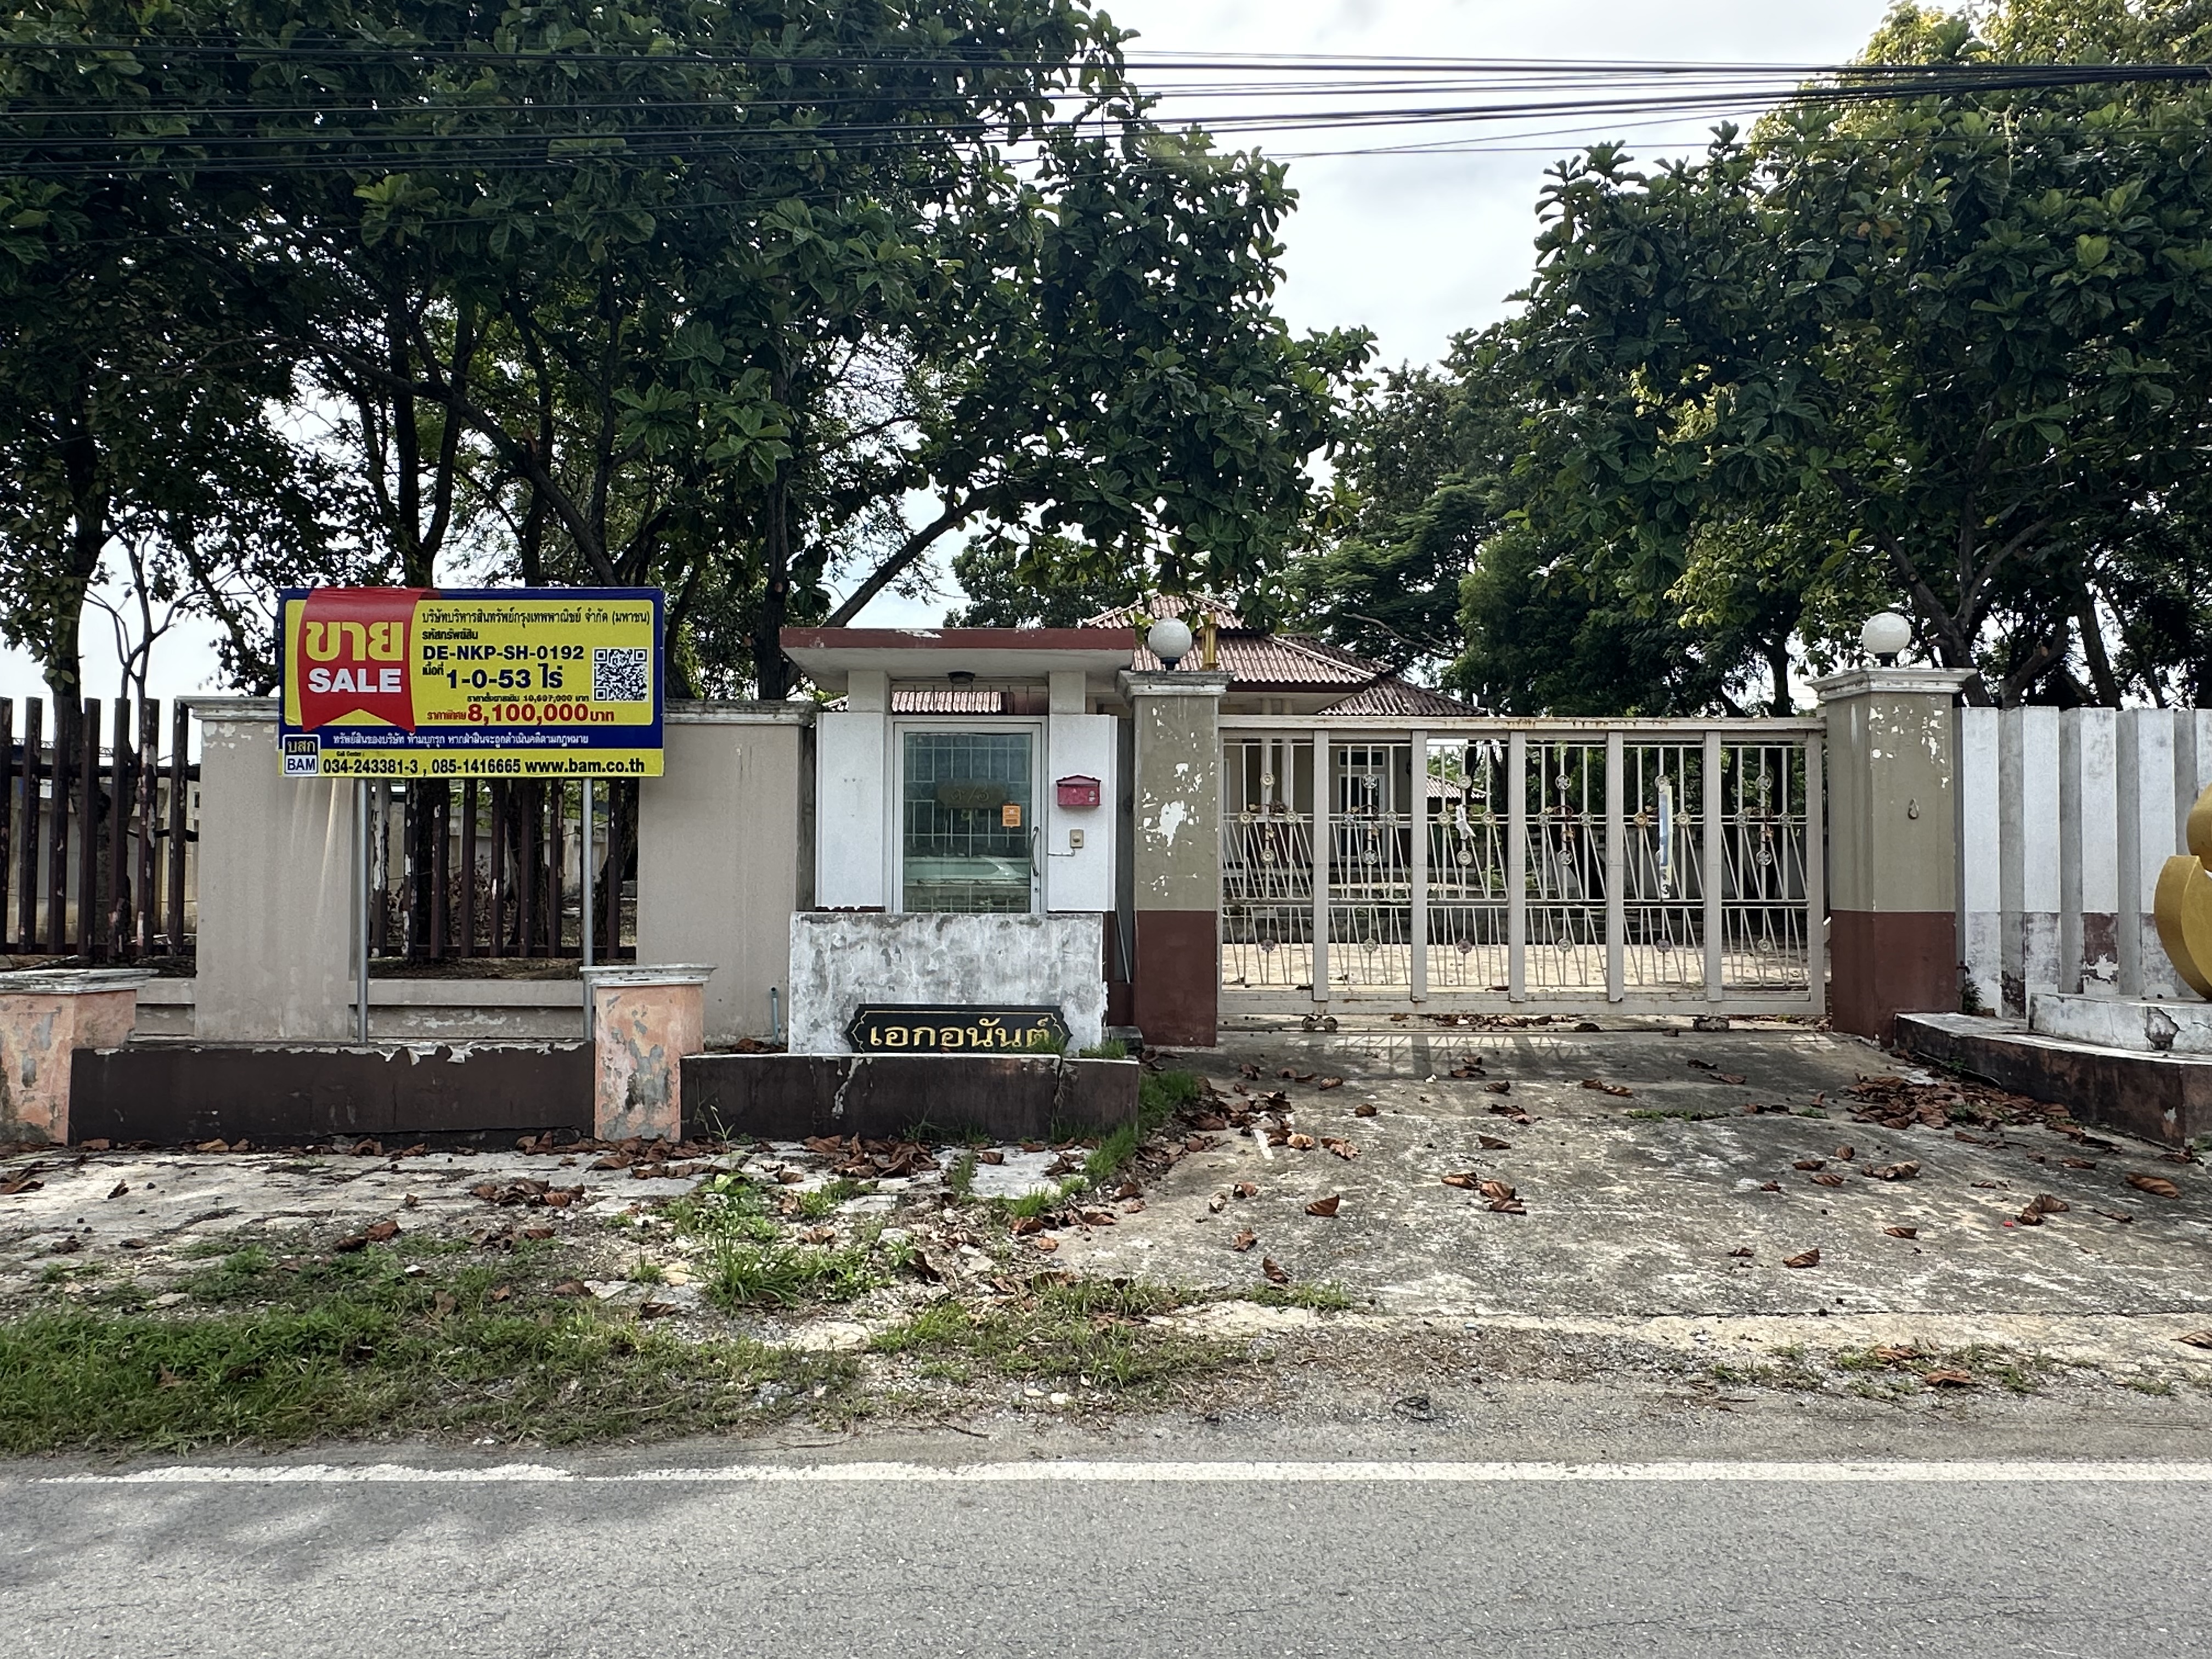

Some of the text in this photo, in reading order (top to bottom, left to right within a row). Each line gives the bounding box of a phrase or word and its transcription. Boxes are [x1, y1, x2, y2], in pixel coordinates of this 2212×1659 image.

[585, 608, 608, 623] จำกัด
[612, 610, 650, 625] (มหาชน)
[306, 621, 404, 662] ขาย
[422, 645, 584, 660] DE-NKP-SH-0192
[308, 667, 402, 693] SALE
[422, 661, 563, 689] เนื้อที่ 1-0-53 ไร่
[467, 703, 589, 726] 8,100,000
[590, 710, 614, 722] บาท
[287, 740, 316, 754] บสก
[287, 758, 316, 771] BAM
[323, 758, 418, 774] 034-243381-3
[432, 759, 521, 774] 085-1416665
[525, 758, 645, 772] www.bam.co.th
[870, 1017, 1049, 1048] เอกอนันต์
